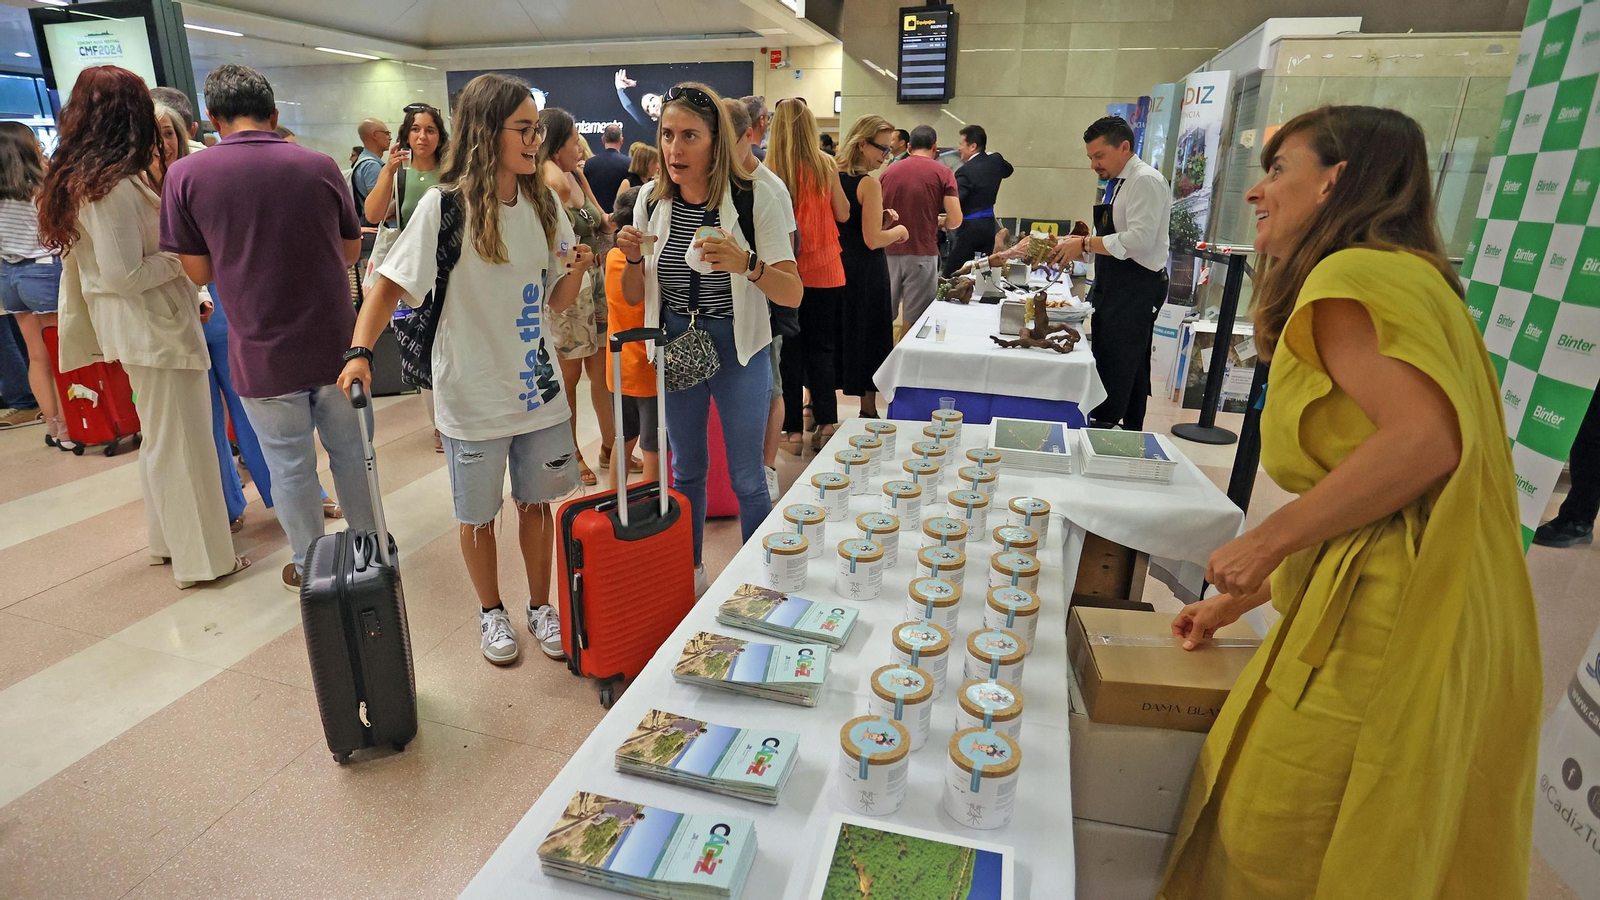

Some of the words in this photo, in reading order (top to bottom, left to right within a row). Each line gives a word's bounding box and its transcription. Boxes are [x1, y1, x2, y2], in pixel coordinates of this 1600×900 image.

[79, 44, 124, 56] CMF2024
[1183, 85, 1215, 105] DIZ
[1522, 113, 1542, 125] Binter
[1558, 106, 1581, 120] Binter
[1503, 180, 1521, 191] Binter
[1536, 180, 1559, 192] Binter
[1484, 244, 1502, 256] Binter
[1514, 248, 1537, 261] Binter
[1550, 252, 1567, 267] Binter
[1582, 258, 1600, 272] Bin
[516, 283, 540, 342] the
[1496, 313, 1516, 328] Binter
[1525, 322, 1543, 338] Binter
[1557, 334, 1596, 352] Binter
[519, 349, 541, 411] ride
[1504, 389, 1521, 406] Binter
[1532, 405, 1565, 425] Binter
[1141, 702, 1181, 714] DAMA
